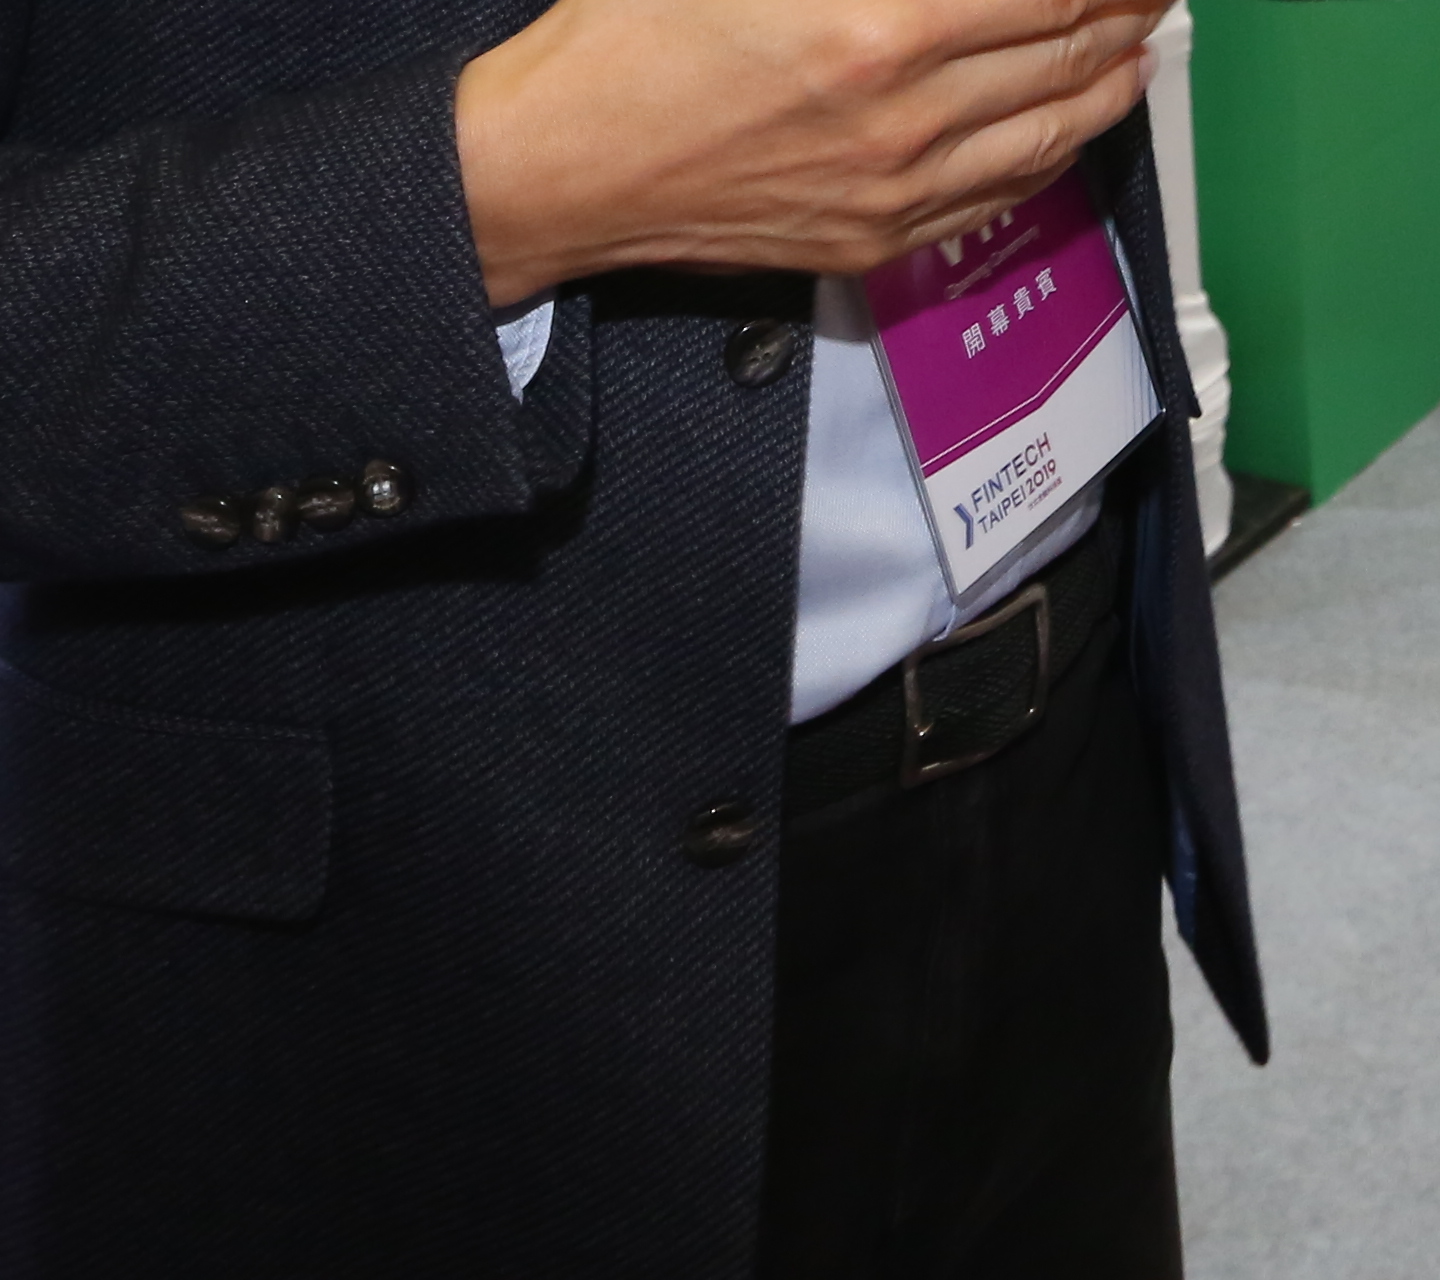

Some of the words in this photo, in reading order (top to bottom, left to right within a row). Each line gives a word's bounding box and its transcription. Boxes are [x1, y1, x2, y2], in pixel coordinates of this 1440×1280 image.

[962, 267, 1057, 358] 開幕貴賓
[971, 432, 1050, 513] FINTECH
